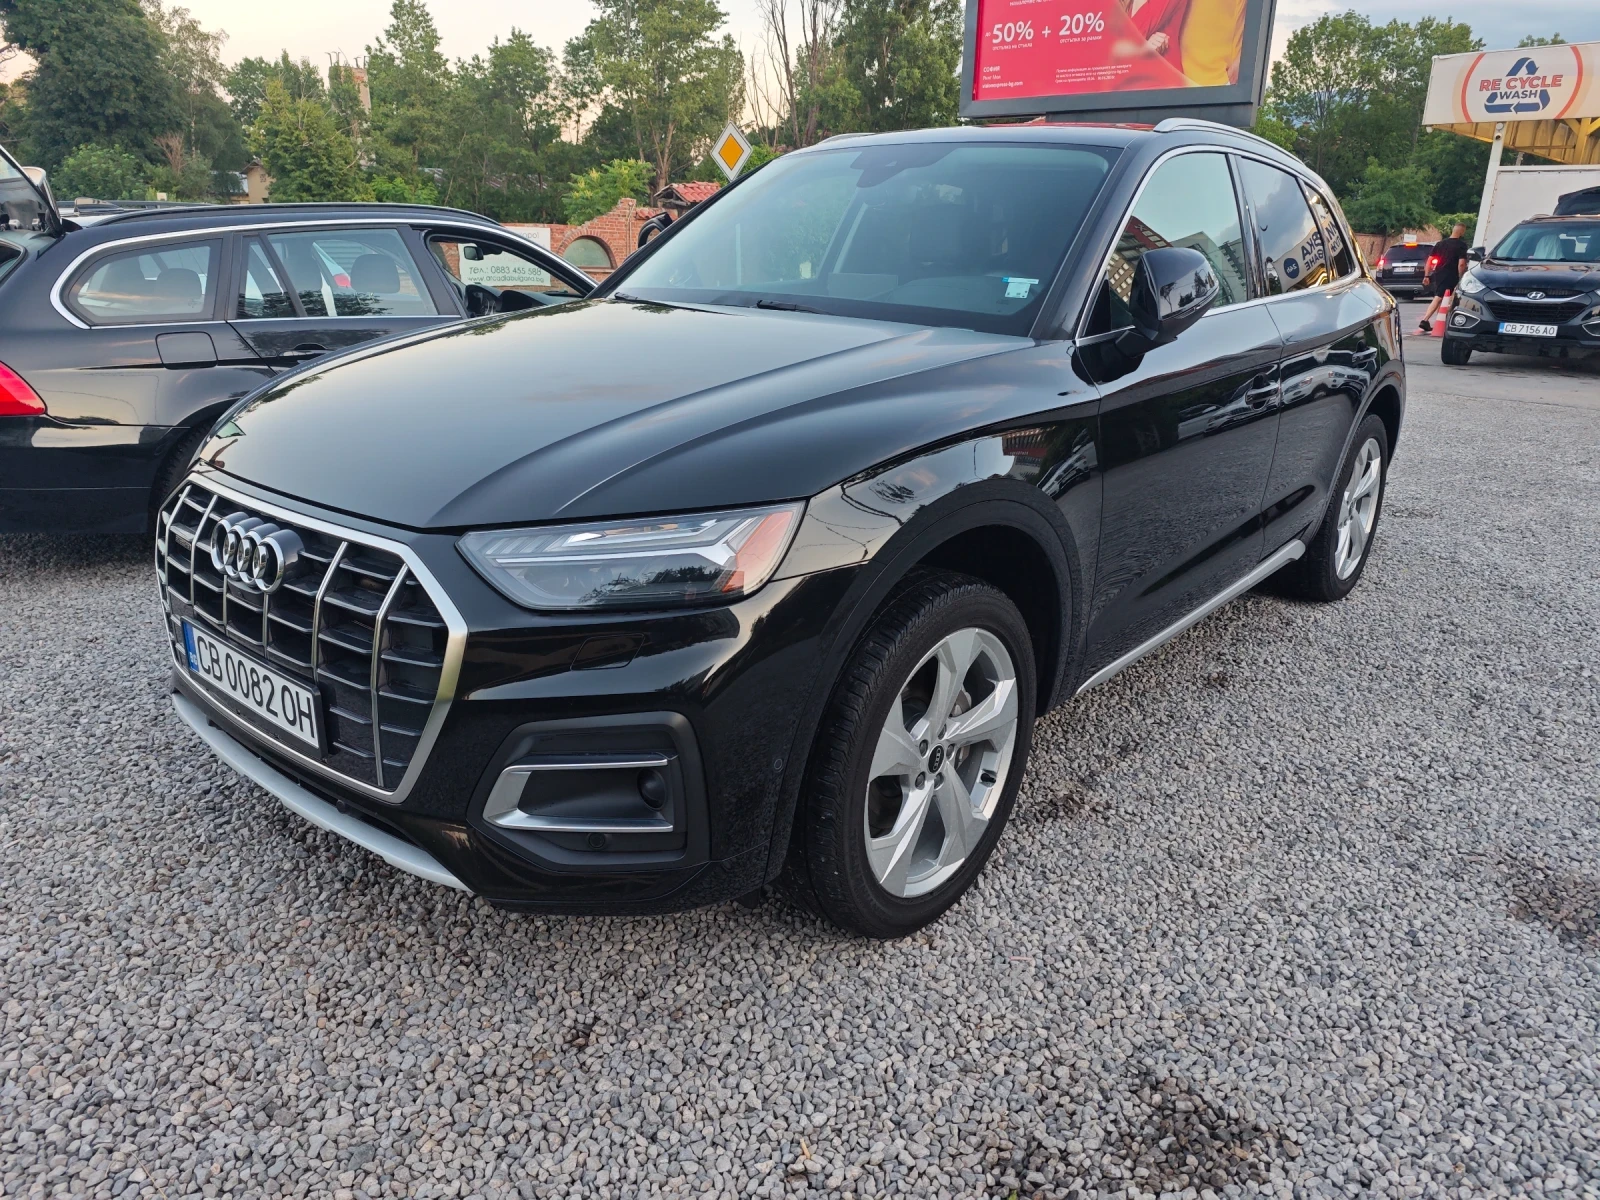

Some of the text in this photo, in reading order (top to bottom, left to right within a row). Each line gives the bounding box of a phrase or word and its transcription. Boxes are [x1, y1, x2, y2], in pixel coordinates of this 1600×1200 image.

[992, 20, 1034, 44] 50%
[1041, 25, 1052, 38] +
[1058, 11, 1105, 36] 20%
[1479, 74, 1564, 92] RE CYCLE
[1499, 89, 1538, 100] WASH
[490, 265, 510, 274] 0883
[512, 266, 526, 275] 455
[1504, 324, 1517, 333] CB
[1518, 325, 1540, 334] 7156
[197, 635, 315, 739] CB 0082 OH
